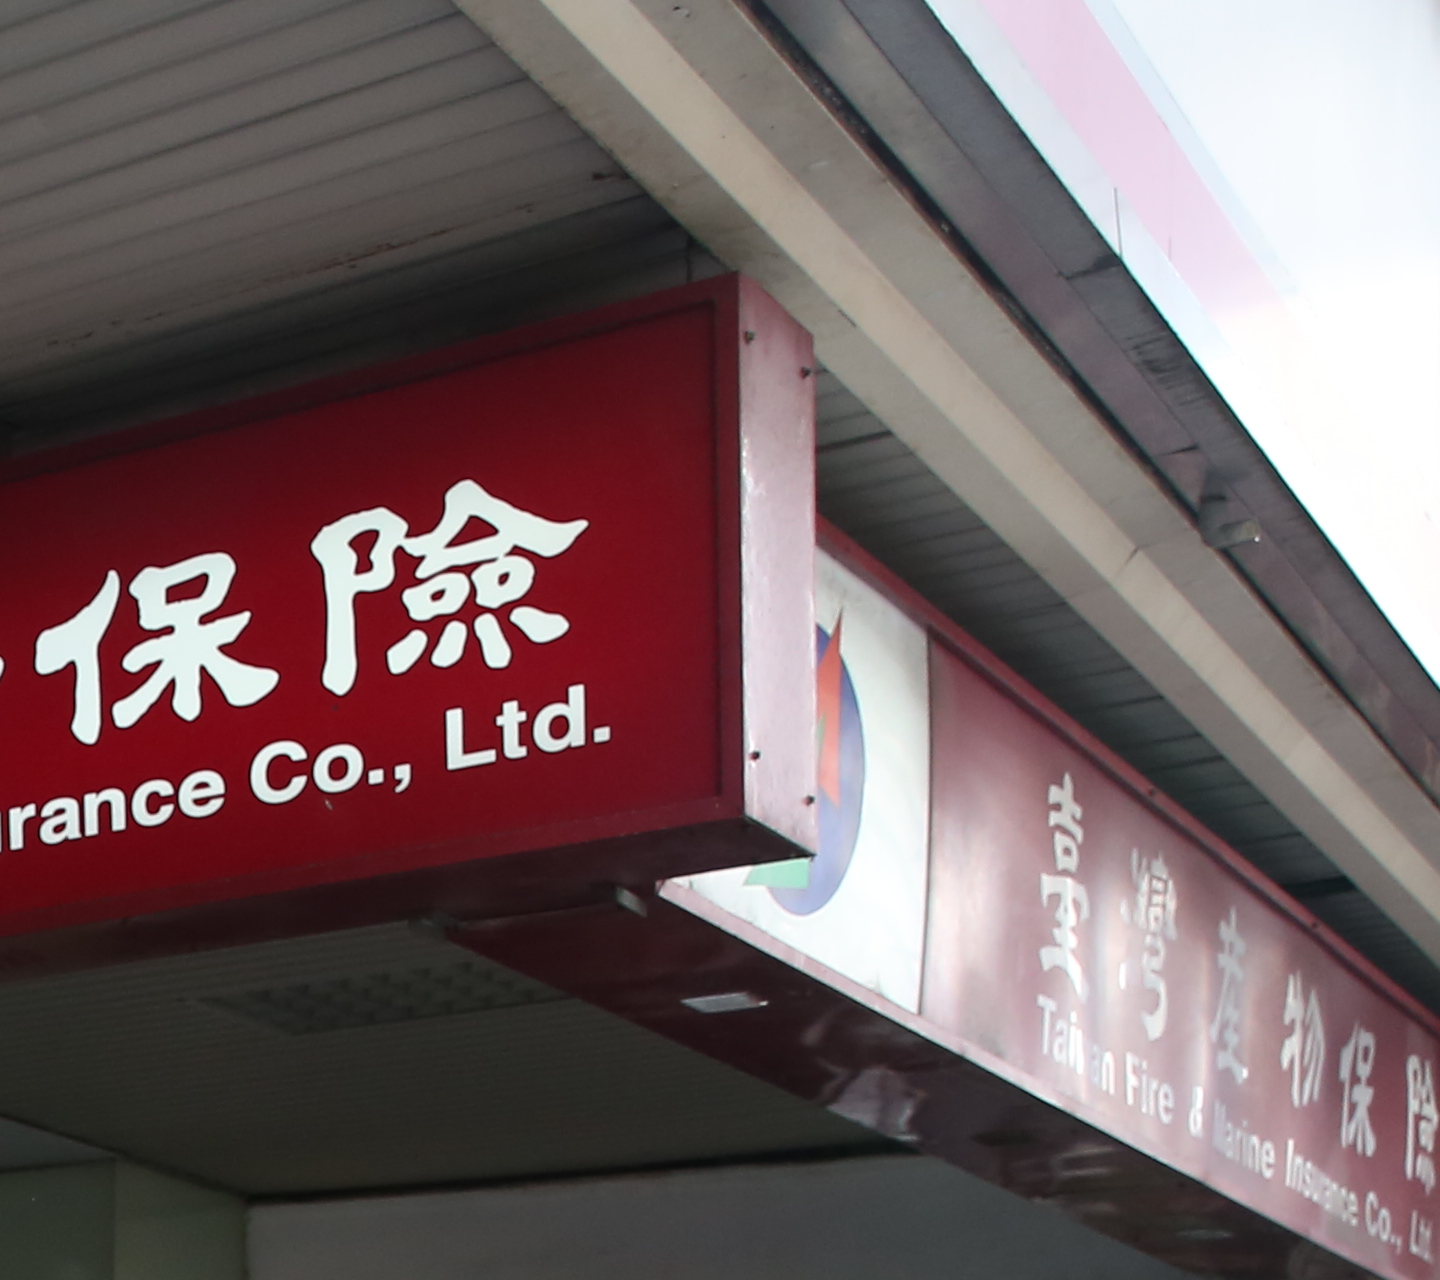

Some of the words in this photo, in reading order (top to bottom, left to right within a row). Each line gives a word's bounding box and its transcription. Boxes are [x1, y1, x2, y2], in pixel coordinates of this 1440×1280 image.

[250, 739, 412, 805] Co.,
[445, 683, 612, 771] Ltd.
[1037, 772, 1439, 1196] 臺灣產物保險
[1036, 994, 1117, 1096] Taiwan
[1124, 1051, 1175, 1124] Fire
[1186, 1085, 1206, 1138] &
[1212, 1102, 1276, 1180] Marine
[1285, 1137, 1359, 1228] Insurance
